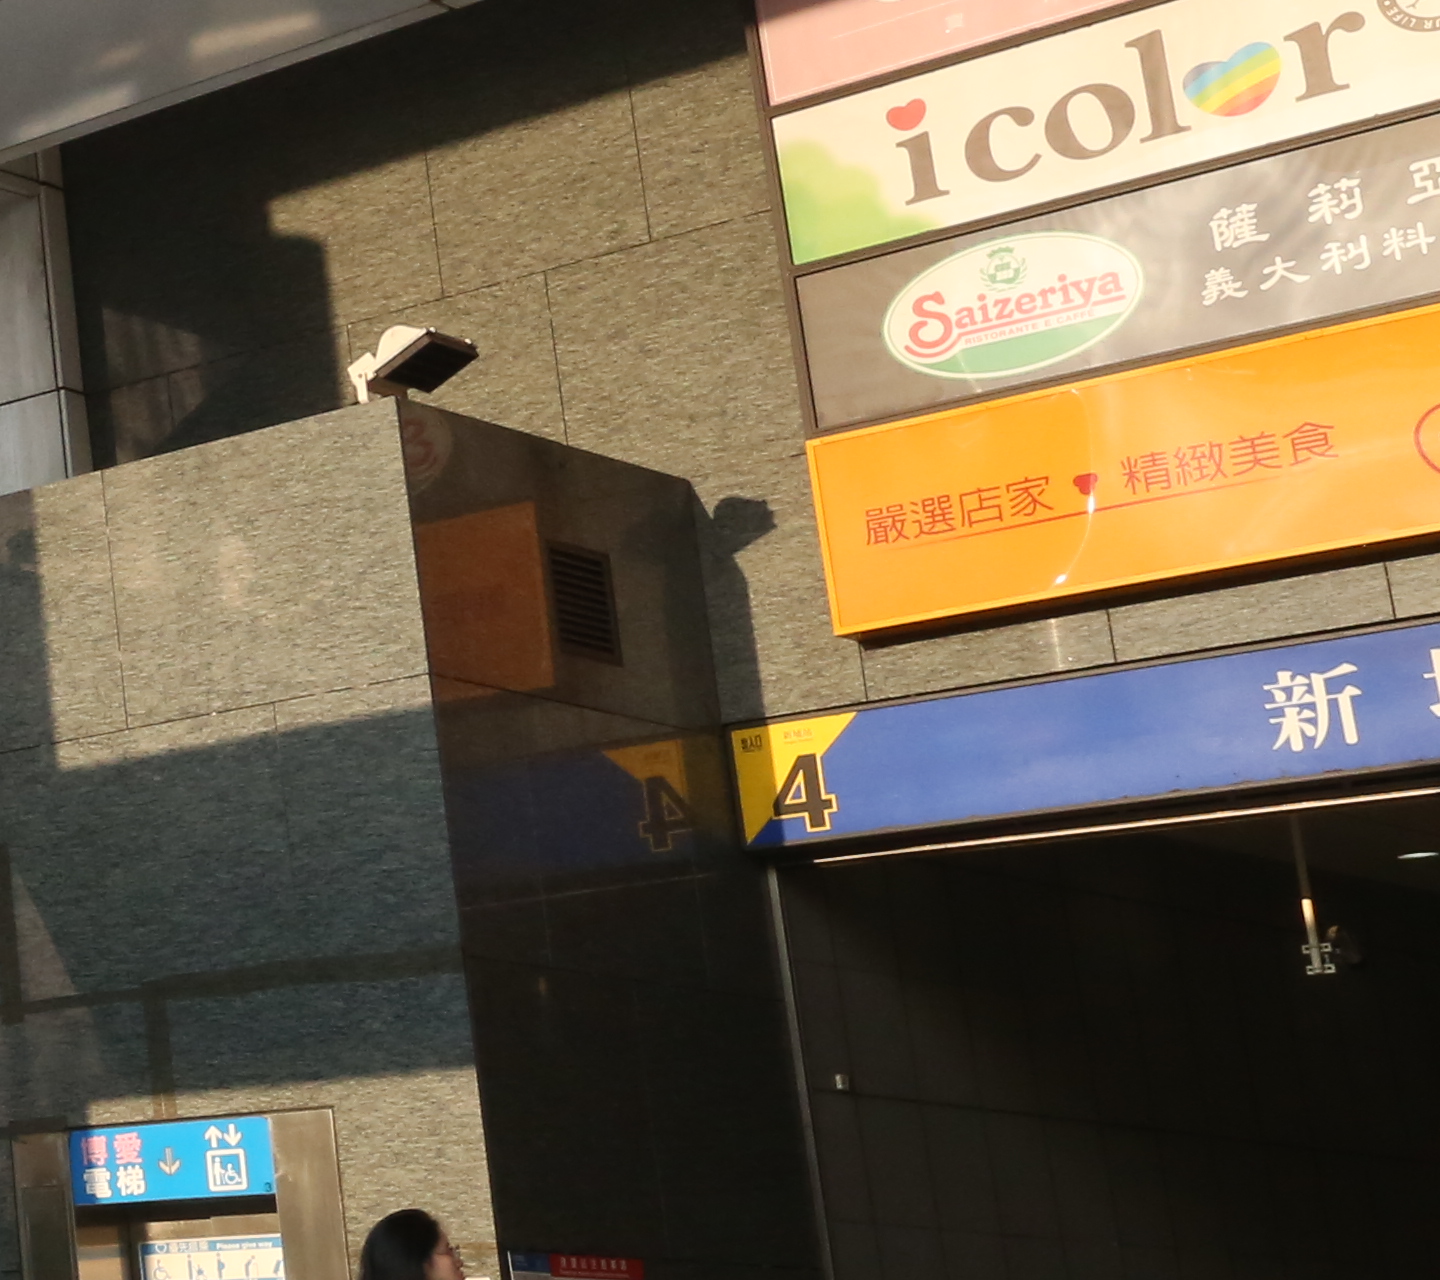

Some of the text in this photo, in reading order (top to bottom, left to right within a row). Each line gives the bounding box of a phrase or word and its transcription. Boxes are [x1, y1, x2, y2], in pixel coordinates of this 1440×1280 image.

[908, 271, 1123, 350] Saizeriya
[963, 321, 1039, 345] RISTORANTE
[865, 420, 1339, 547] 嚴選店家 精緻美食
[773, 753, 834, 830] 4
[82, 1131, 143, 1165] 博愛
[84, 1165, 147, 1198] 電梯
